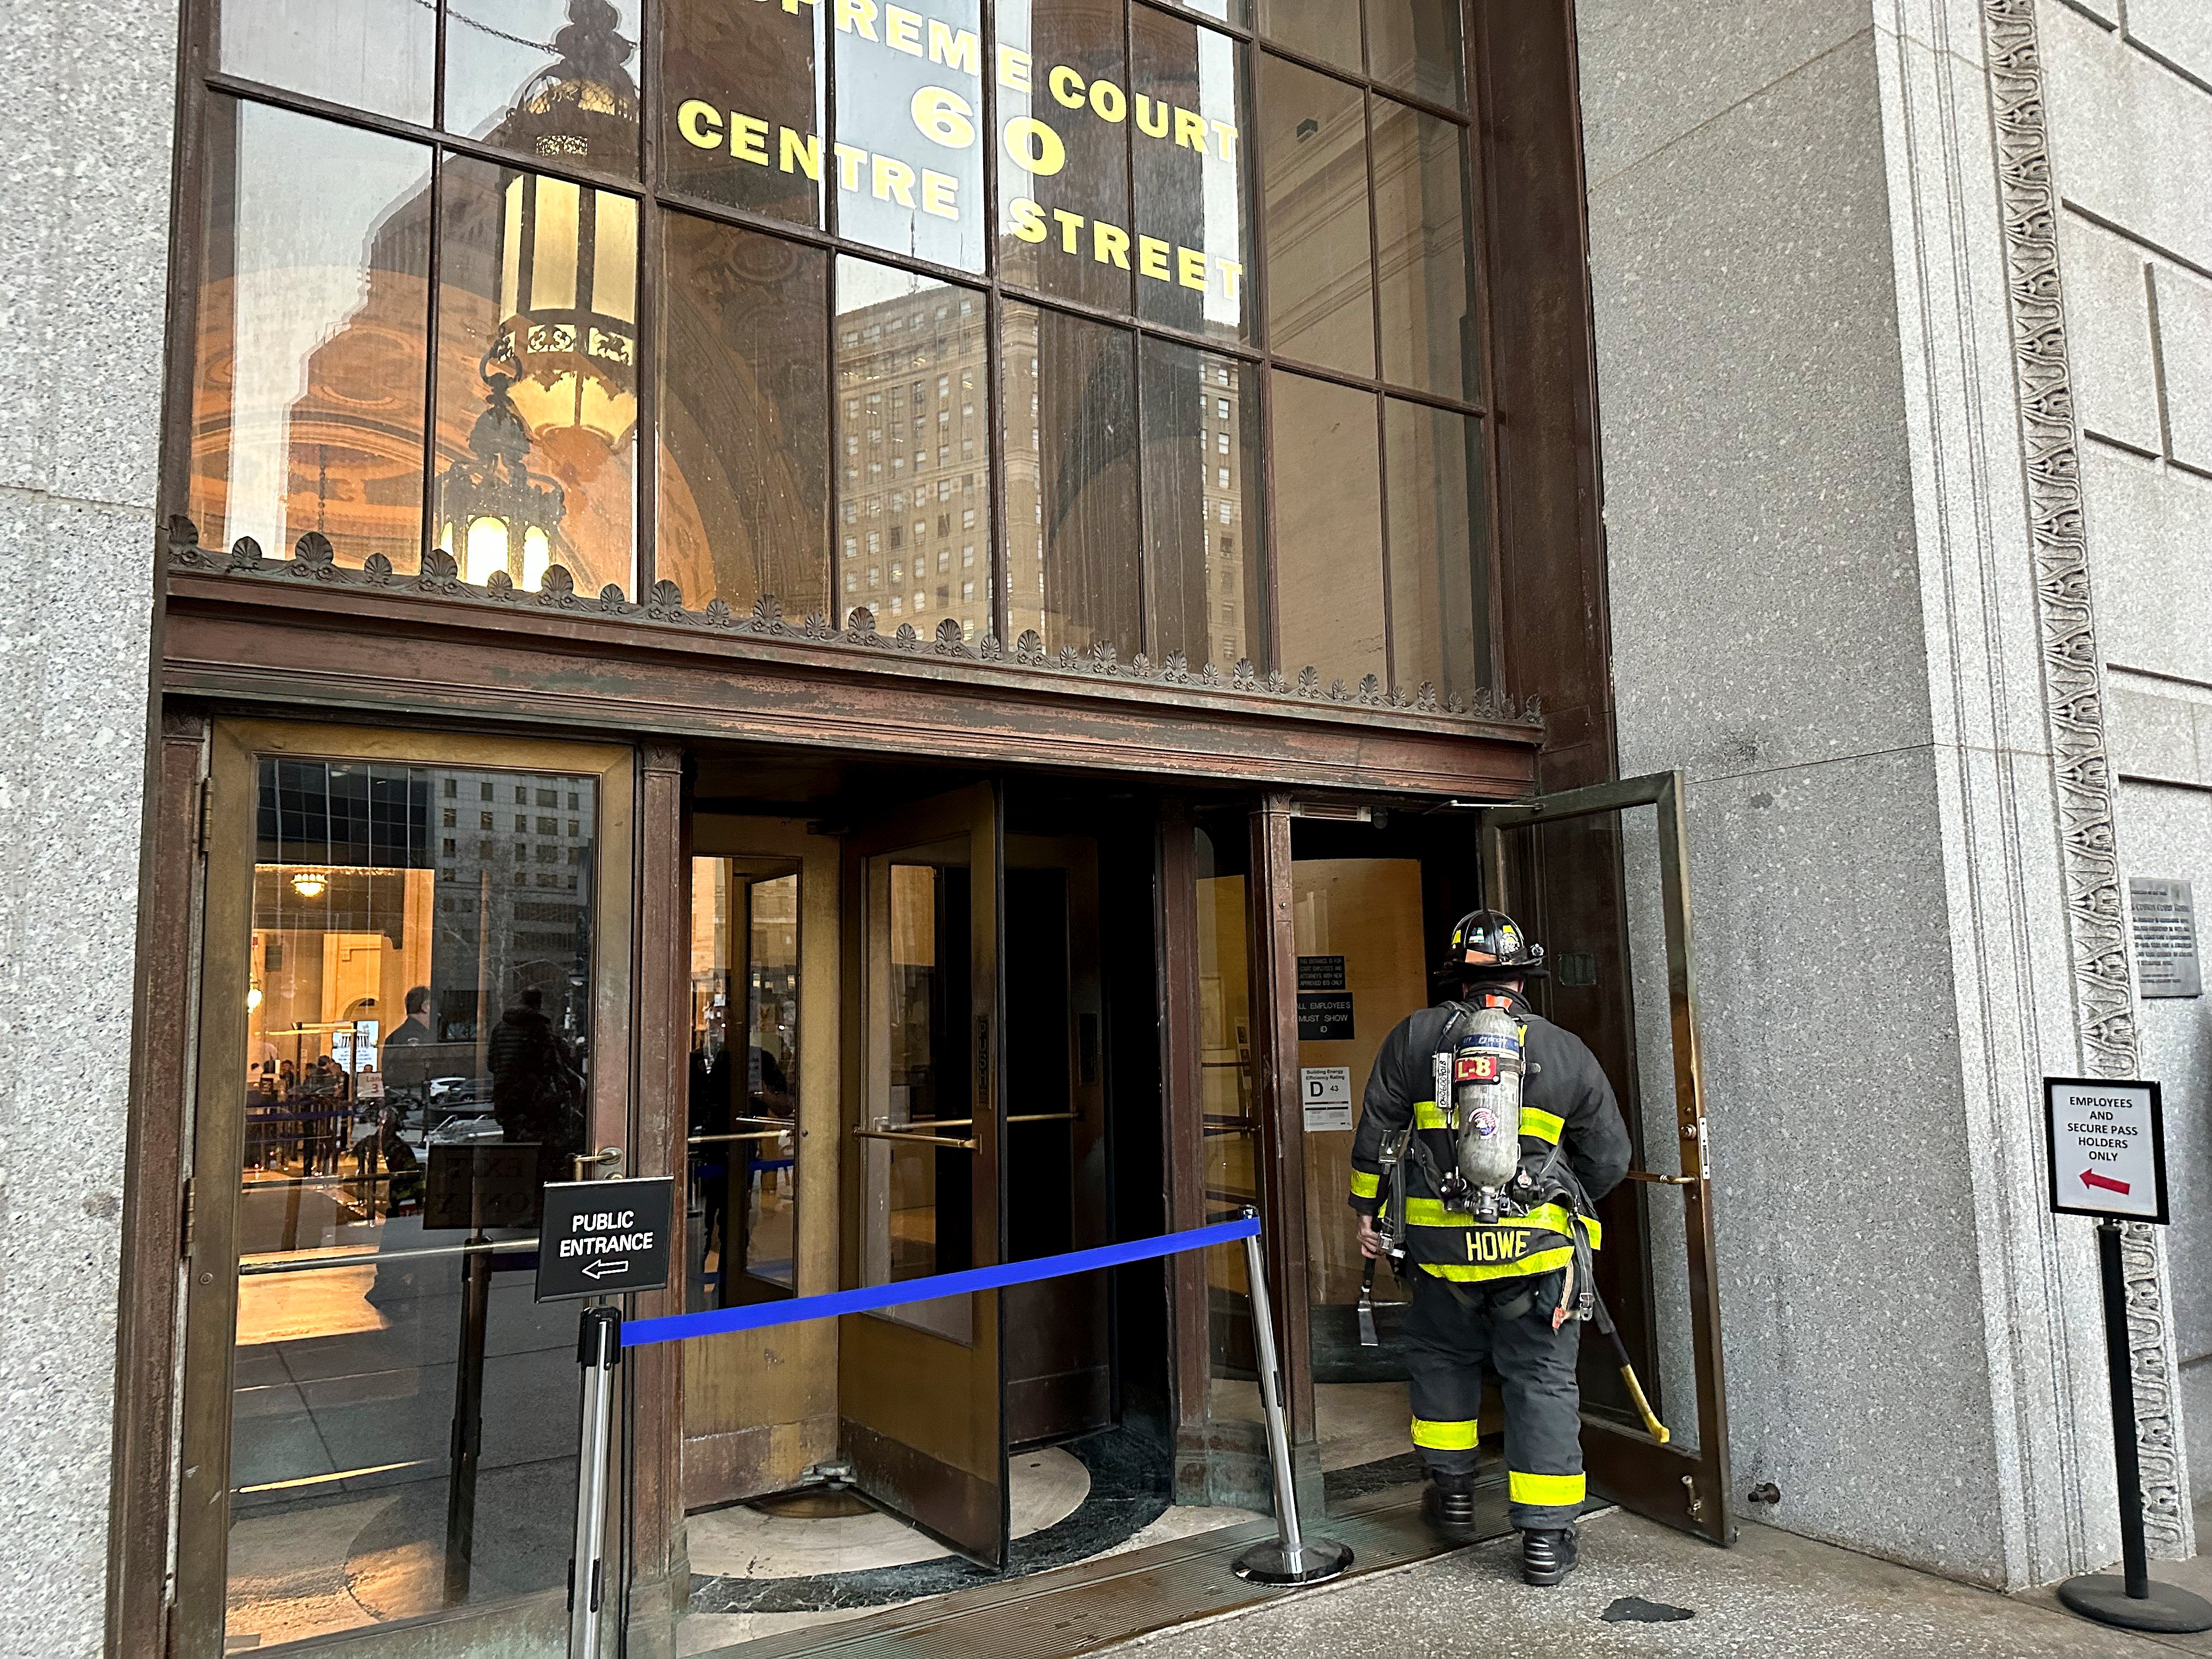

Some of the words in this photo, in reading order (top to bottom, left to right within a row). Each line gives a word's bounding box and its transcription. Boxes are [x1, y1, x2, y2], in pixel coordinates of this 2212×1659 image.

[754, 0, 1032, 94] REME
[1049, 65, 1238, 163] COURT
[677, 99, 960, 221] CENTRE
[1007, 198, 1243, 301] STREET
[372, 1084, 378, 1093] 3
[1310, 1081, 1323, 1097] D
[2070, 1097, 2132, 1108] EMPLOYEES
[2090, 1111, 2113, 1120] AND
[2067, 1123, 2108, 1133] SECURE
[2111, 1126, 2137, 1135] PASS
[2079, 1137, 2128, 1148] HOLDERS
[2089, 1151, 2118, 1161] ONLY
[572, 1210, 634, 1232] PUBLIC
[560, 1232, 653, 1257] ENTRANCE
[1466, 1231, 1531, 1261] HOWE
